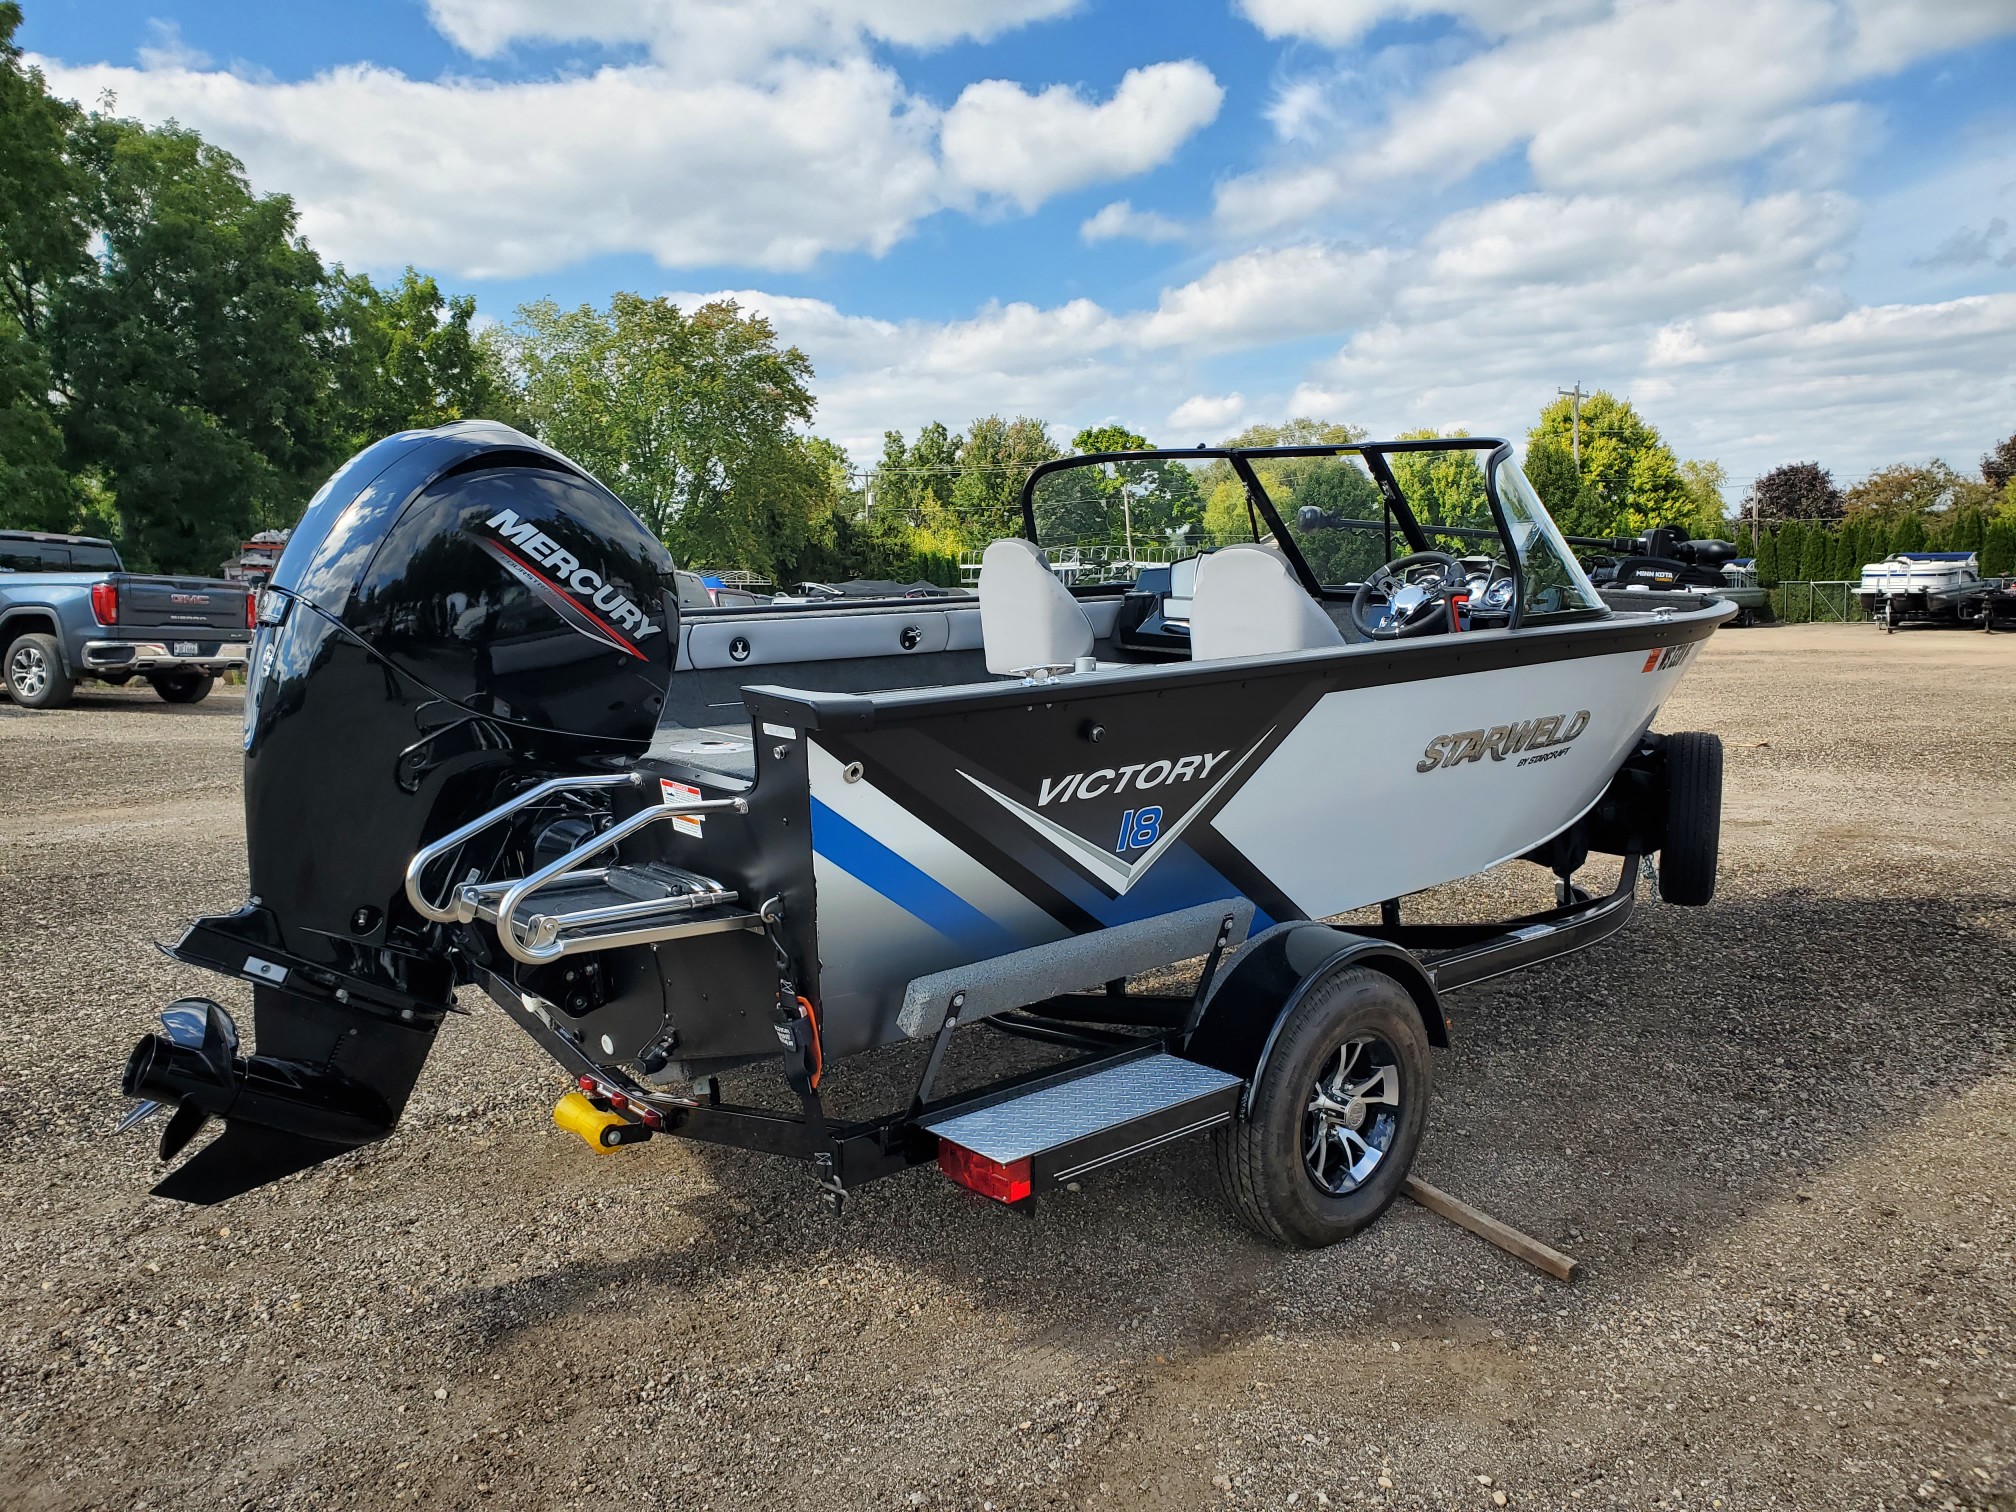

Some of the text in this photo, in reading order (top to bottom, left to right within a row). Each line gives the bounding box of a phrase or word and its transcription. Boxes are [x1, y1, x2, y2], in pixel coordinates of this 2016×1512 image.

[171, 594, 210, 605] GMC
[485, 508, 662, 640] MERCURY
[1416, 709, 1591, 773] STARWELD
[1516, 746, 1572, 767] BY STARCRAFT
[1037, 749, 1231, 807] VICTORY
[1115, 805, 1164, 853] 18
